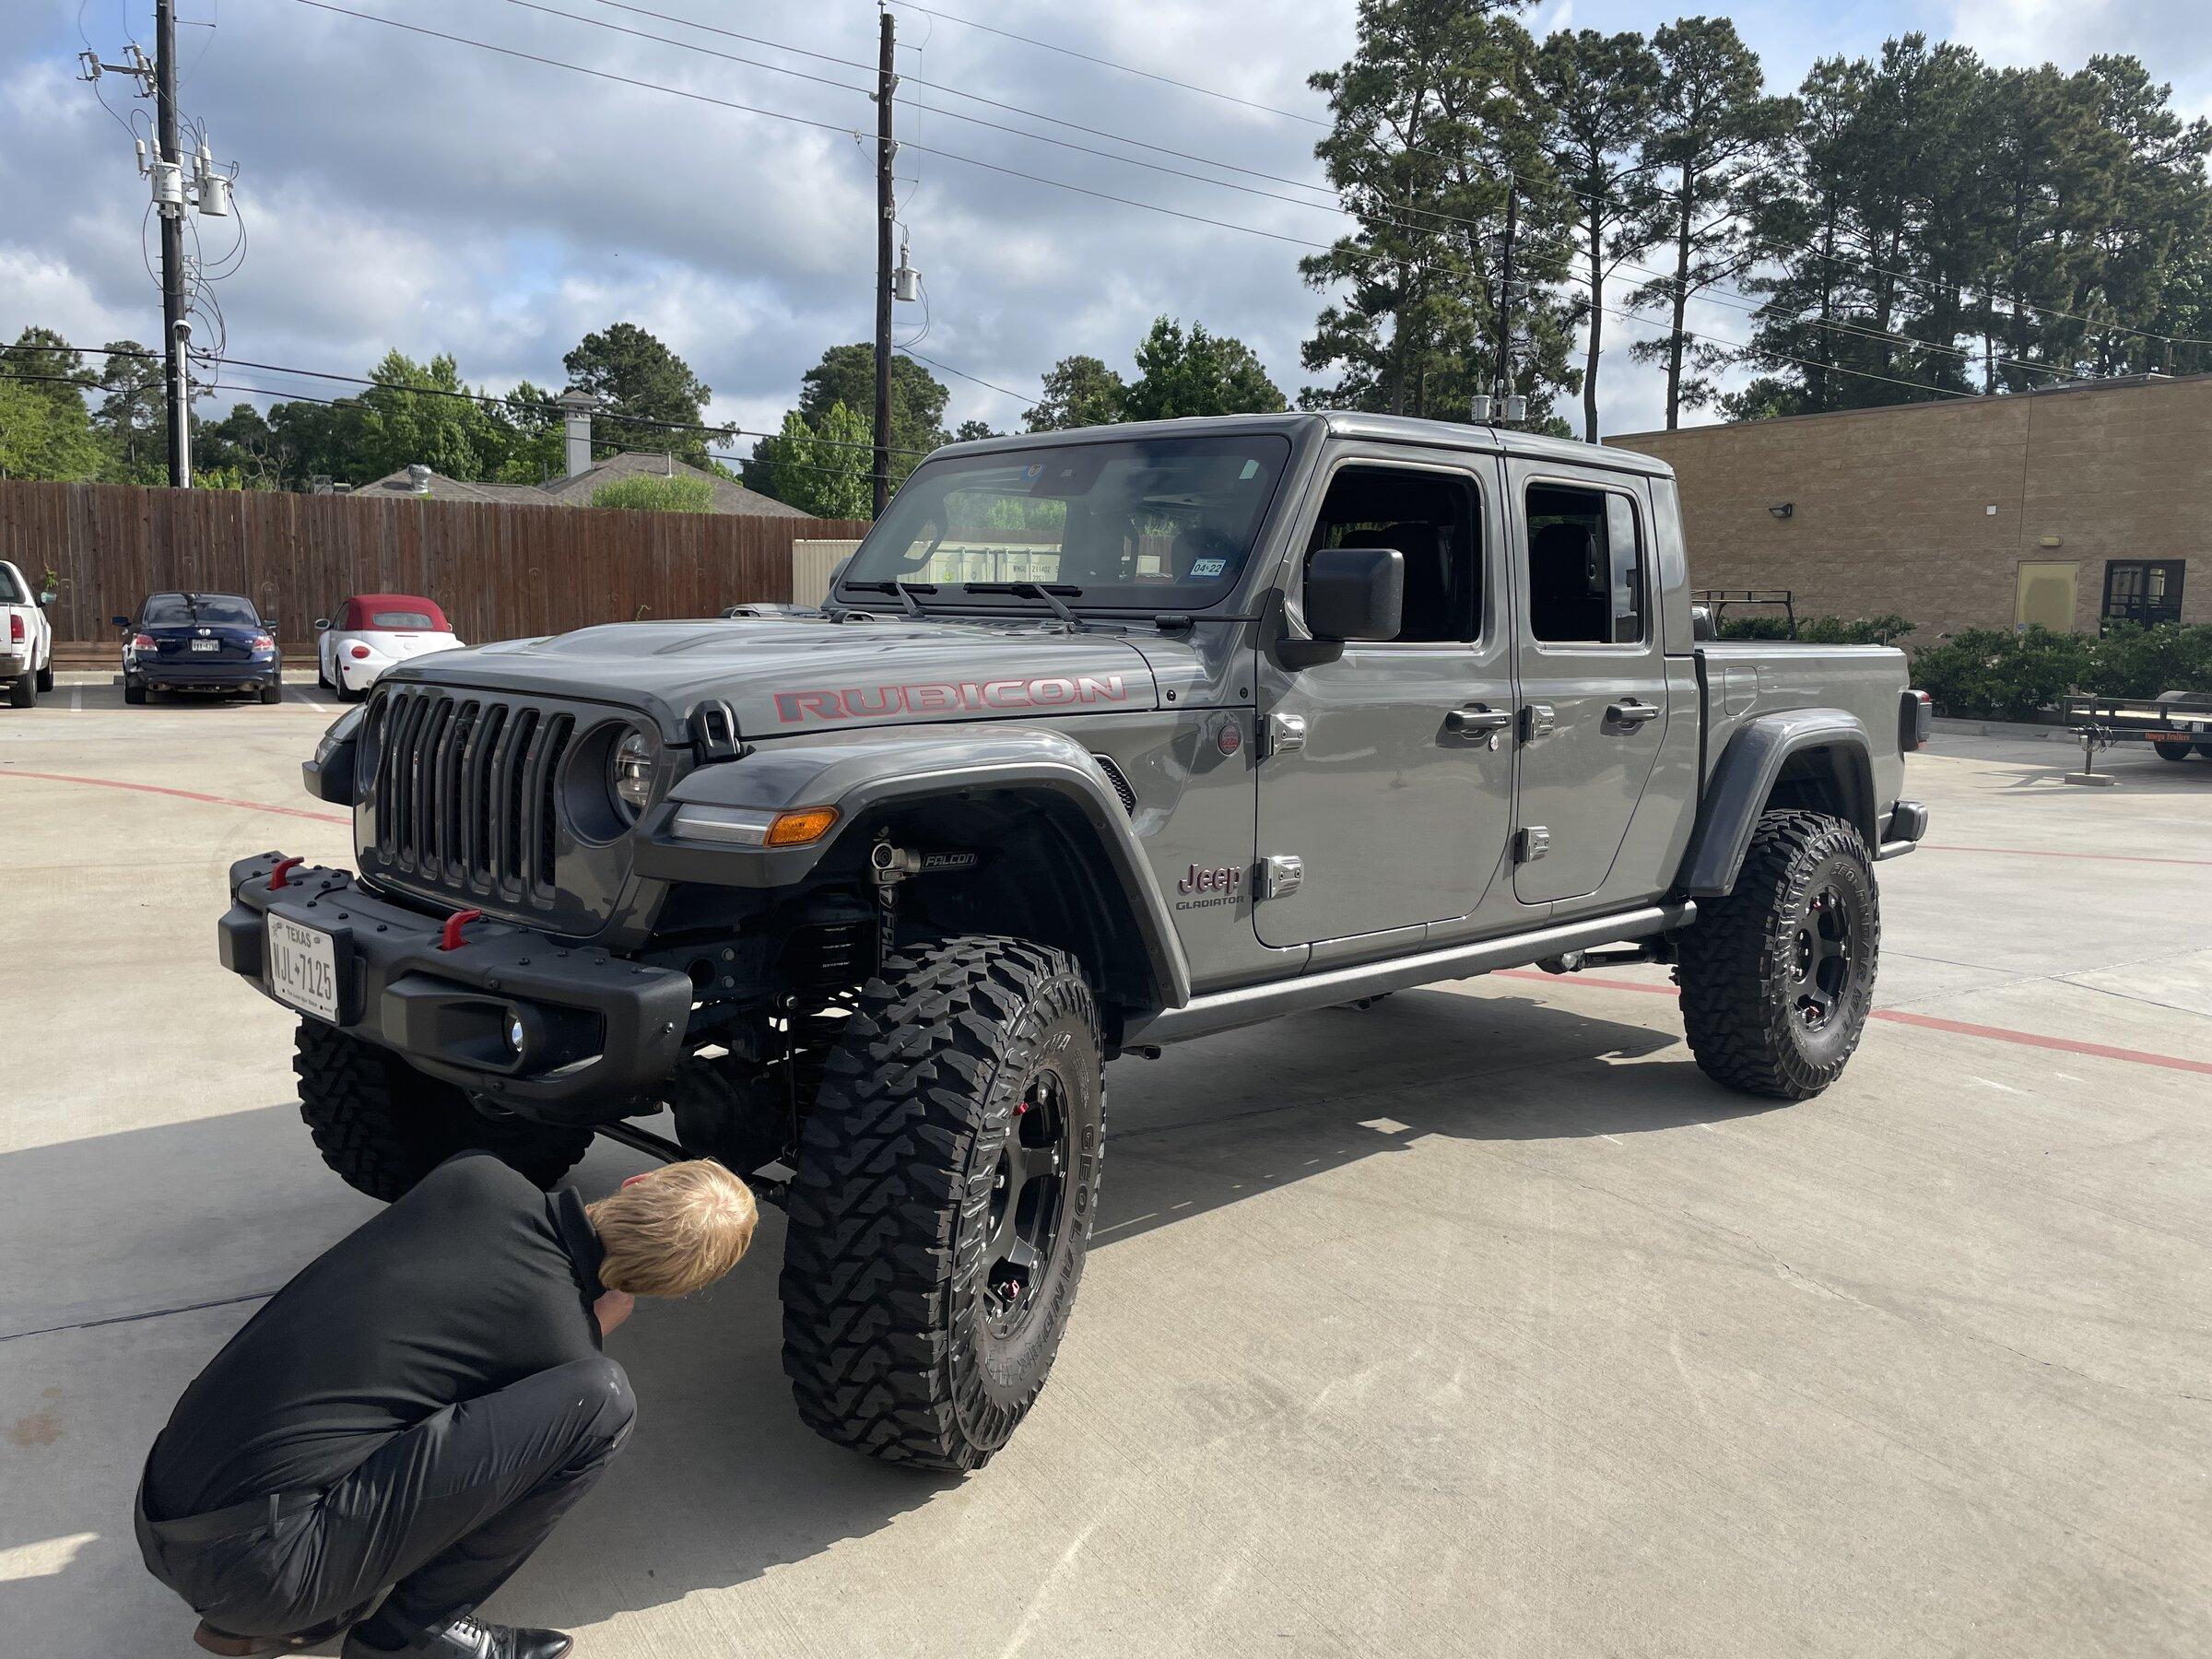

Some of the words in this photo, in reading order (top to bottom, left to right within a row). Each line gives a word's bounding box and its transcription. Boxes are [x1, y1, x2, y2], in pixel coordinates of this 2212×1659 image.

[1194, 564, 1206, 572] 04
[773, 675, 1127, 724] RUBICON
[924, 853, 975, 866] FALCON
[1178, 864, 1241, 896] Jeep
[1176, 896, 1244, 911] GLADIATOR
[286, 924, 312, 947] TEXAS
